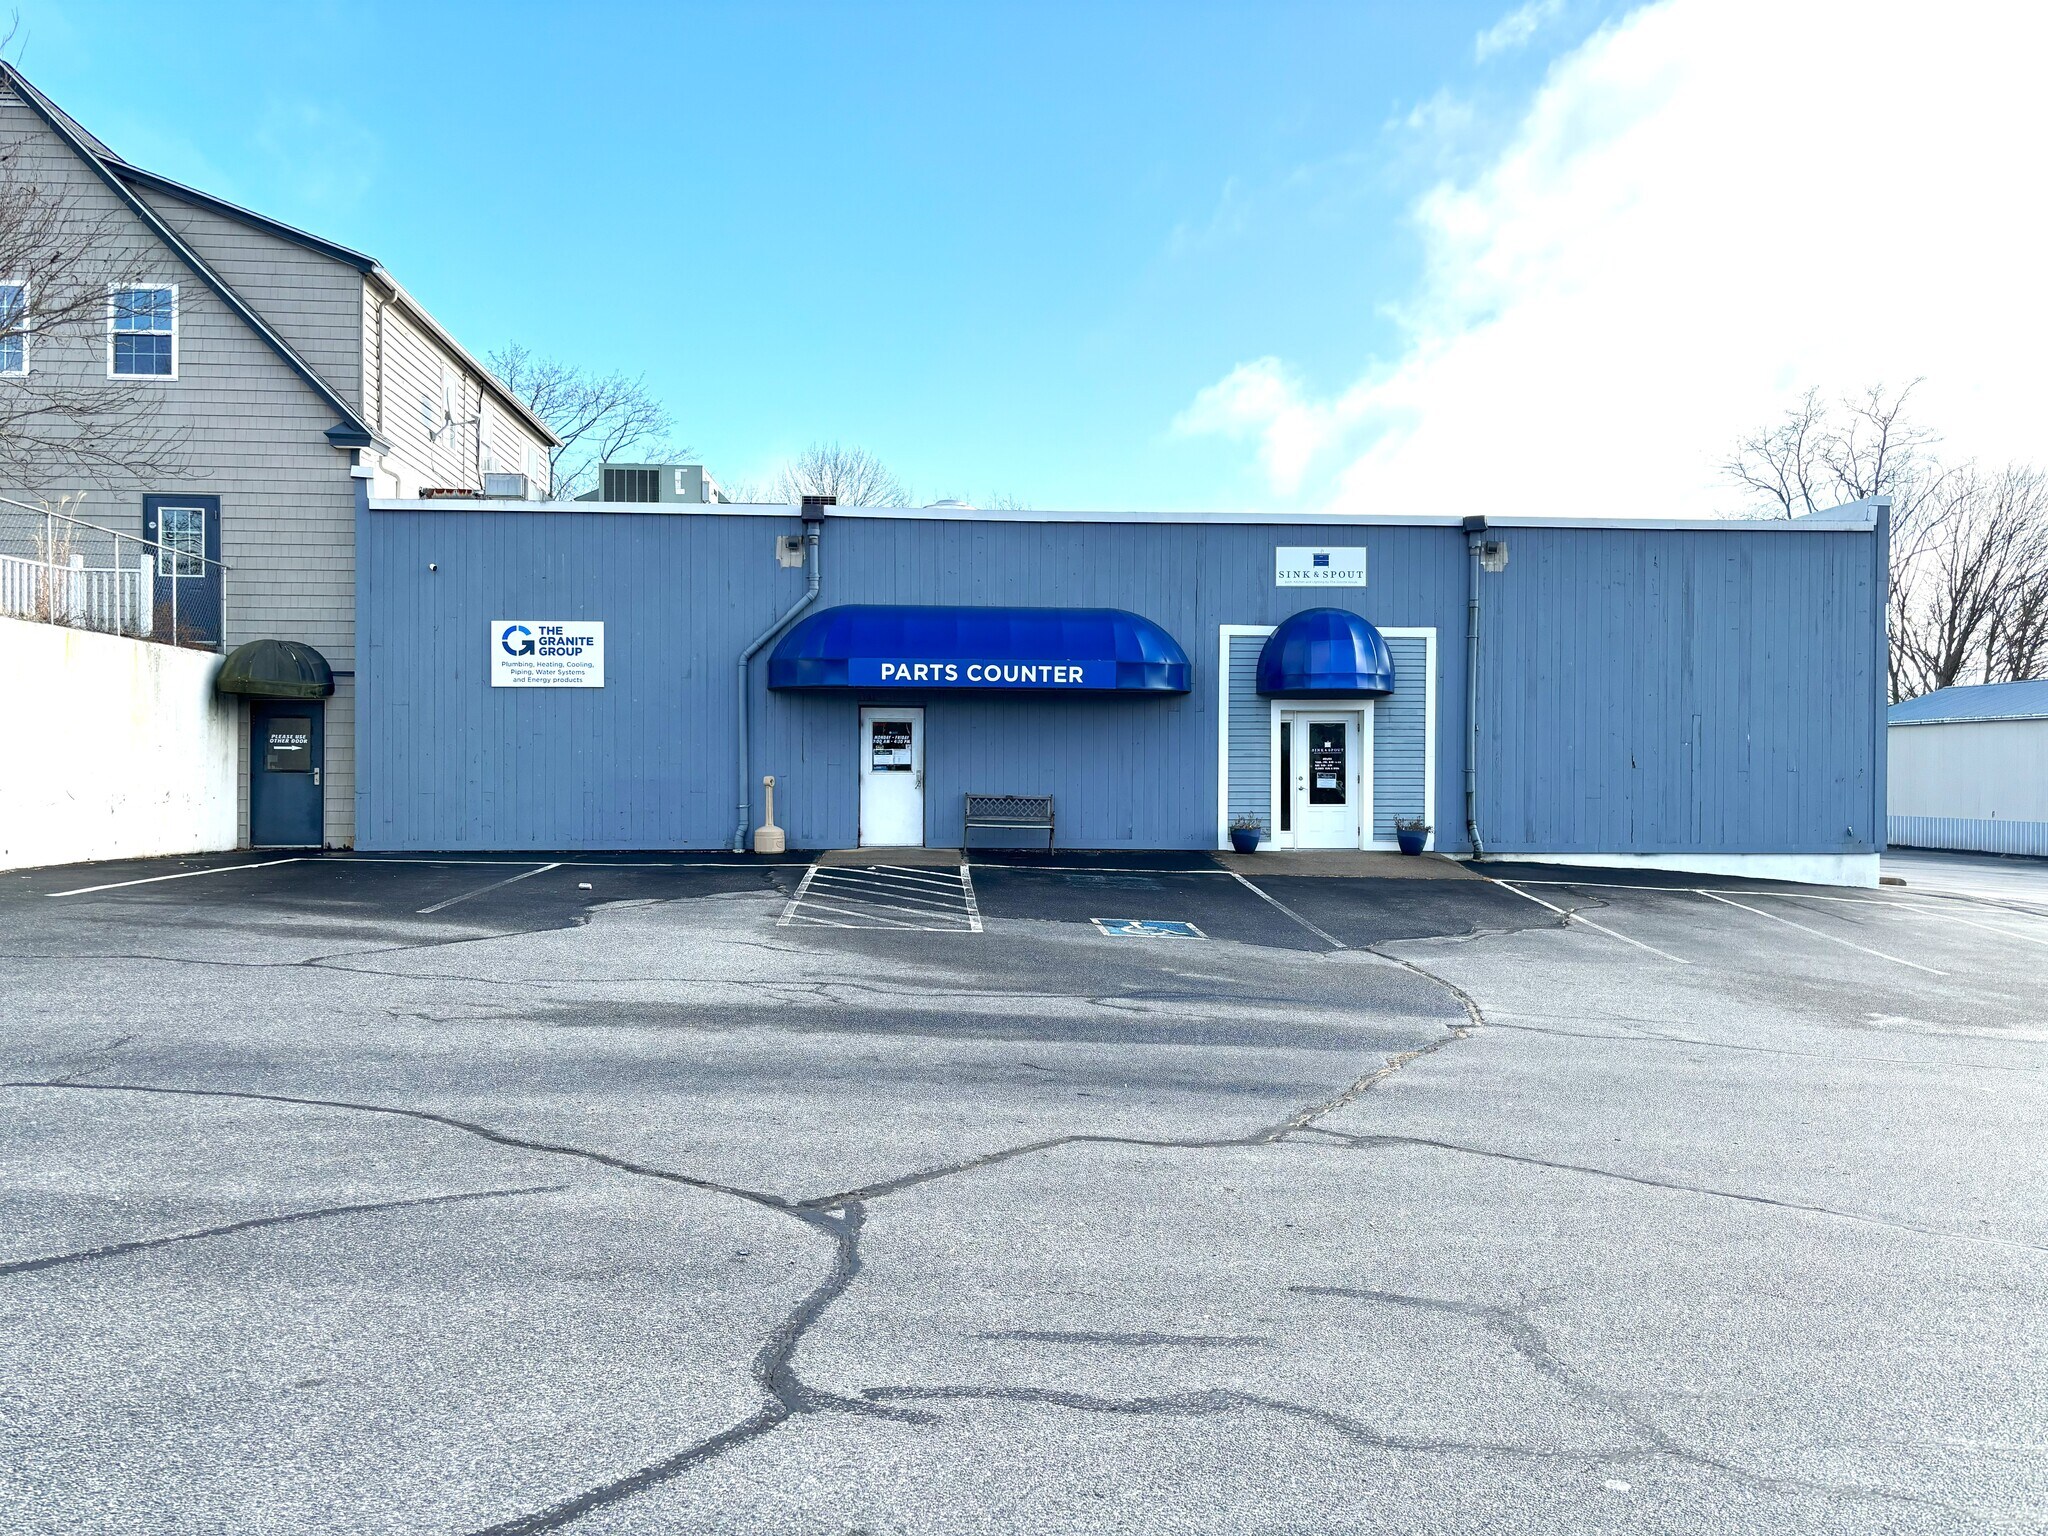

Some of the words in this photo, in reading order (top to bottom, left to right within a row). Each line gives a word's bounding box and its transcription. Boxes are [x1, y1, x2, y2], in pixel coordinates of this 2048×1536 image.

[1278, 571, 1310, 579] SINK
[1322, 571, 1364, 579] SPOUT
[539, 626, 563, 635] THE
[539, 637, 594, 646] GRANITE
[539, 647, 583, 656] GROUP
[536, 661, 565, 669] Heating,
[566, 661, 594, 669] Cooling,
[881, 663, 958, 681] PARTS
[966, 665, 1083, 683] COUNTER
